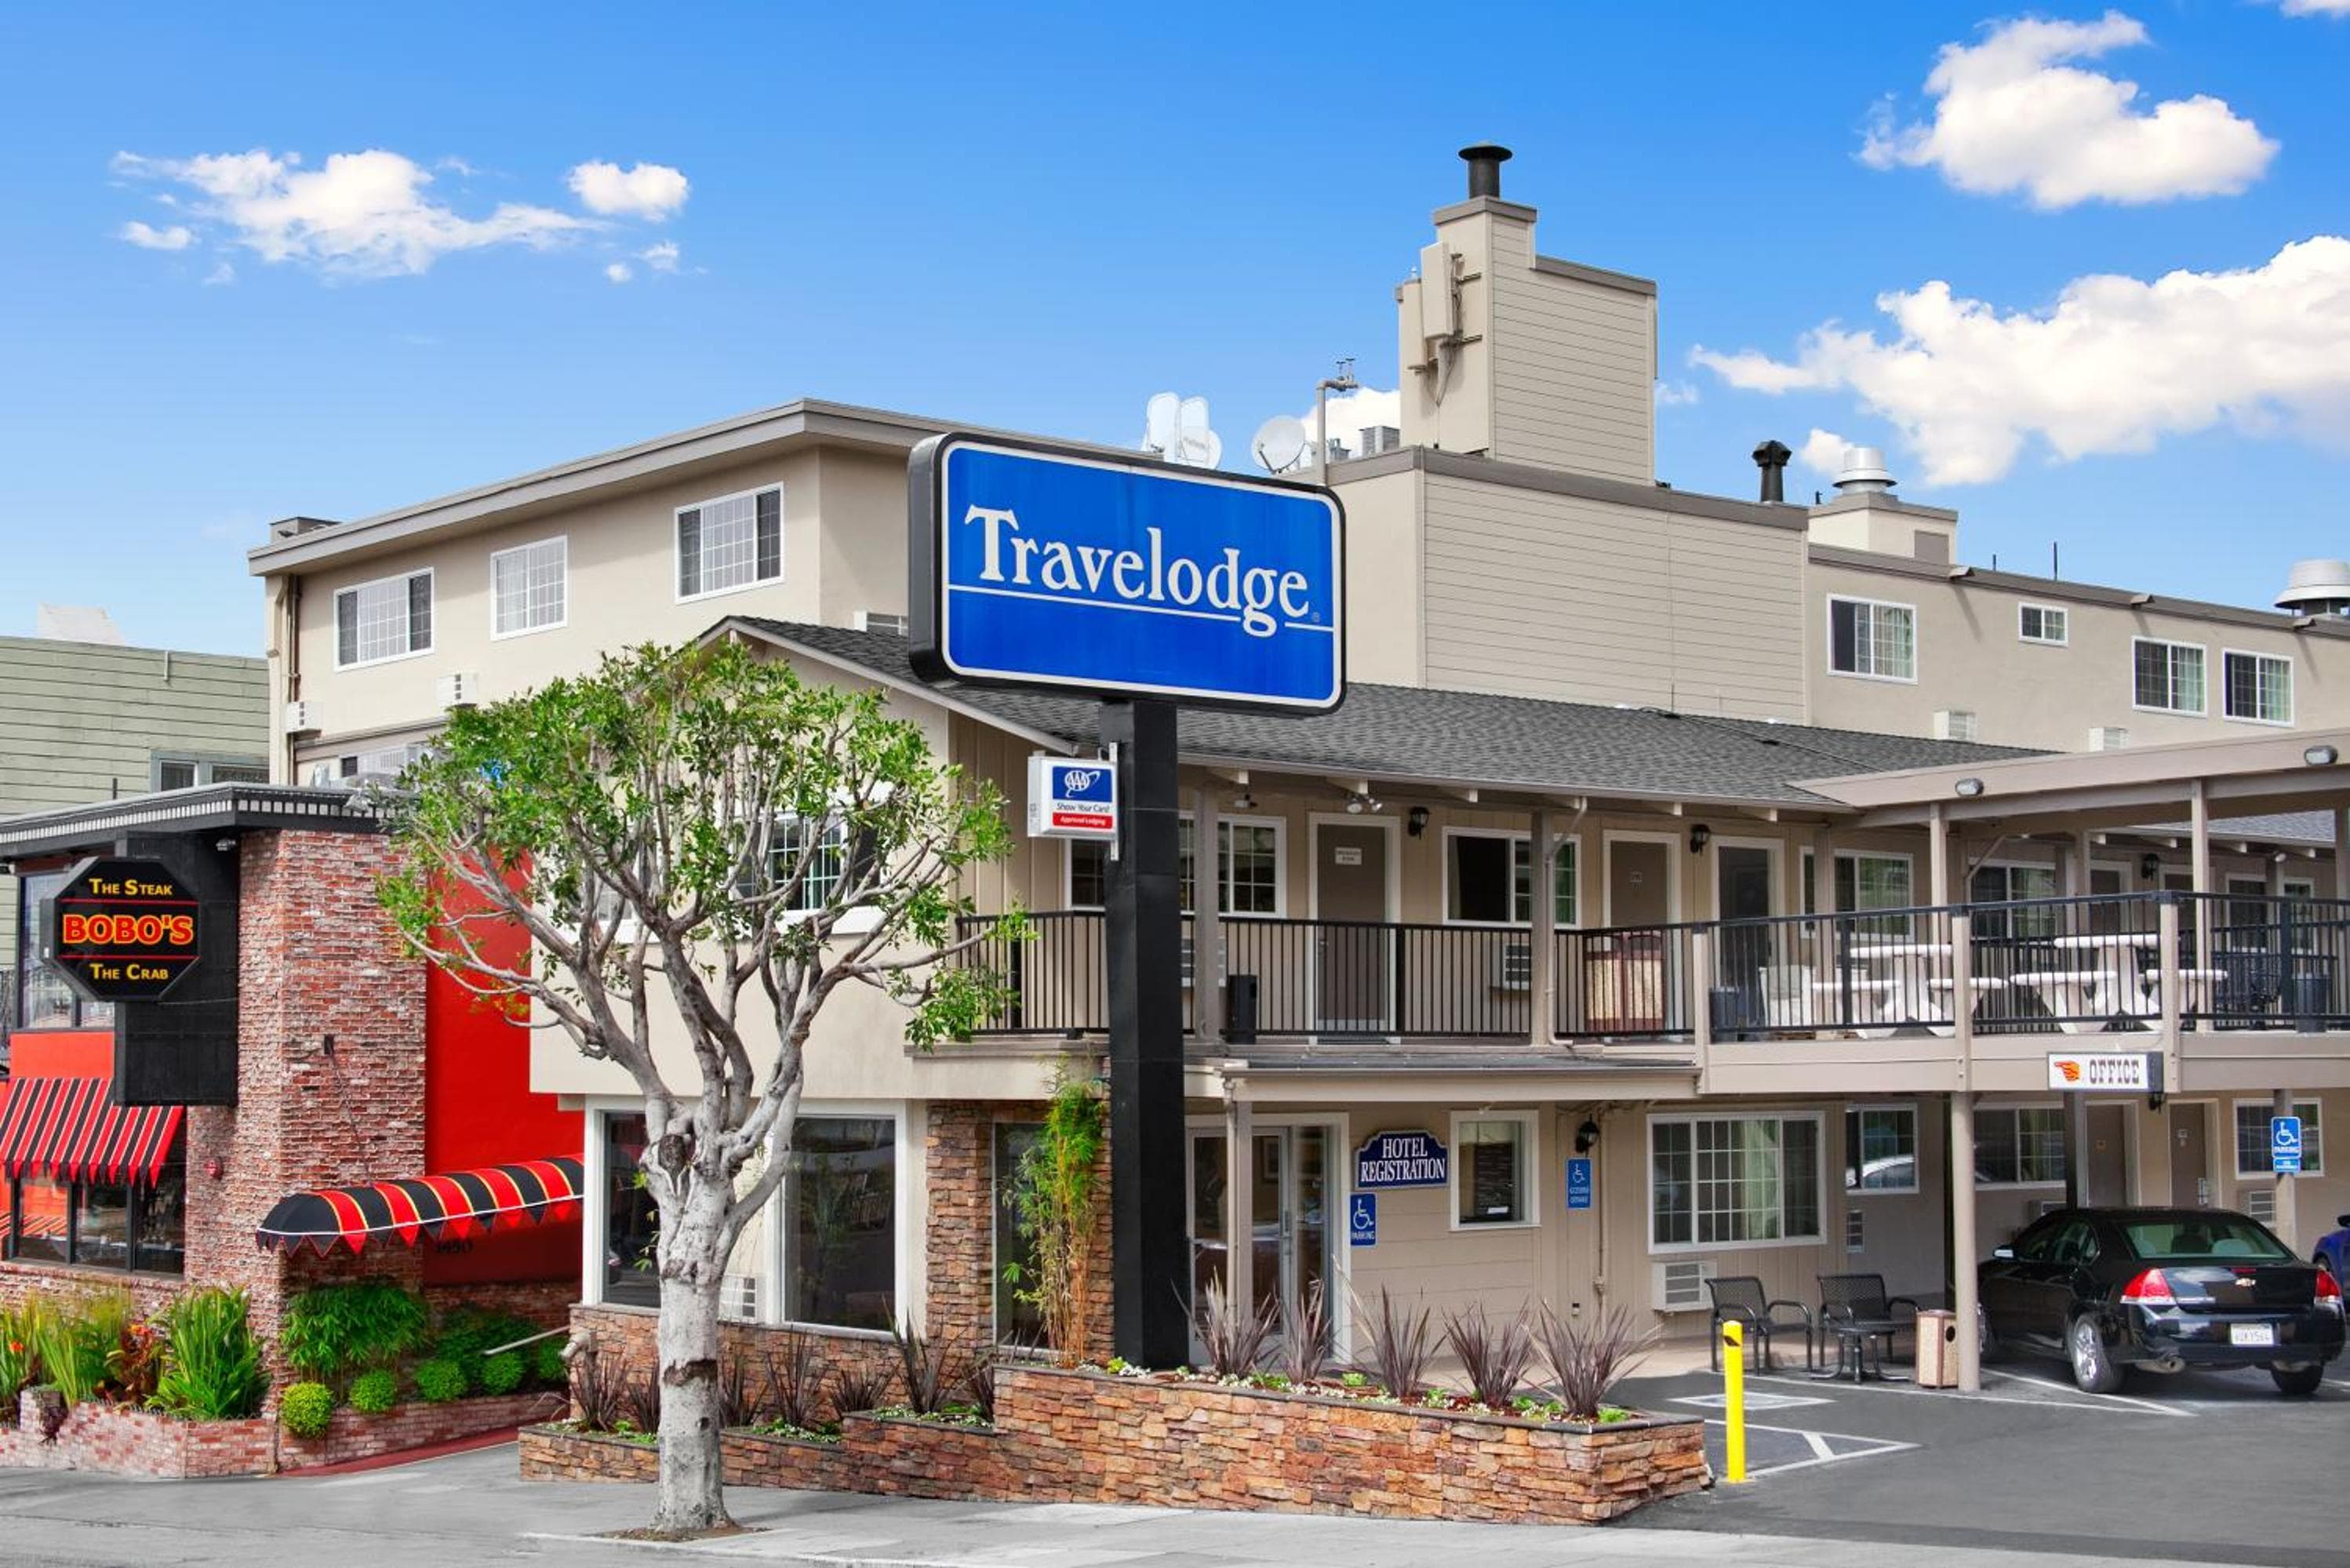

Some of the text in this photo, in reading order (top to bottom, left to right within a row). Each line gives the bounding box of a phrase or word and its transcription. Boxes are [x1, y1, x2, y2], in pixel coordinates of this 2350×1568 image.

[965, 504, 1308, 638] Travelodge
[1093, 804, 1110, 813] Card
[63, 914, 194, 945] BOBO'S
[2089, 1059, 2140, 1084] OFFICE
[1382, 1137, 1428, 1159] HOTEL
[1360, 1157, 1446, 1182] REGISTRATION
